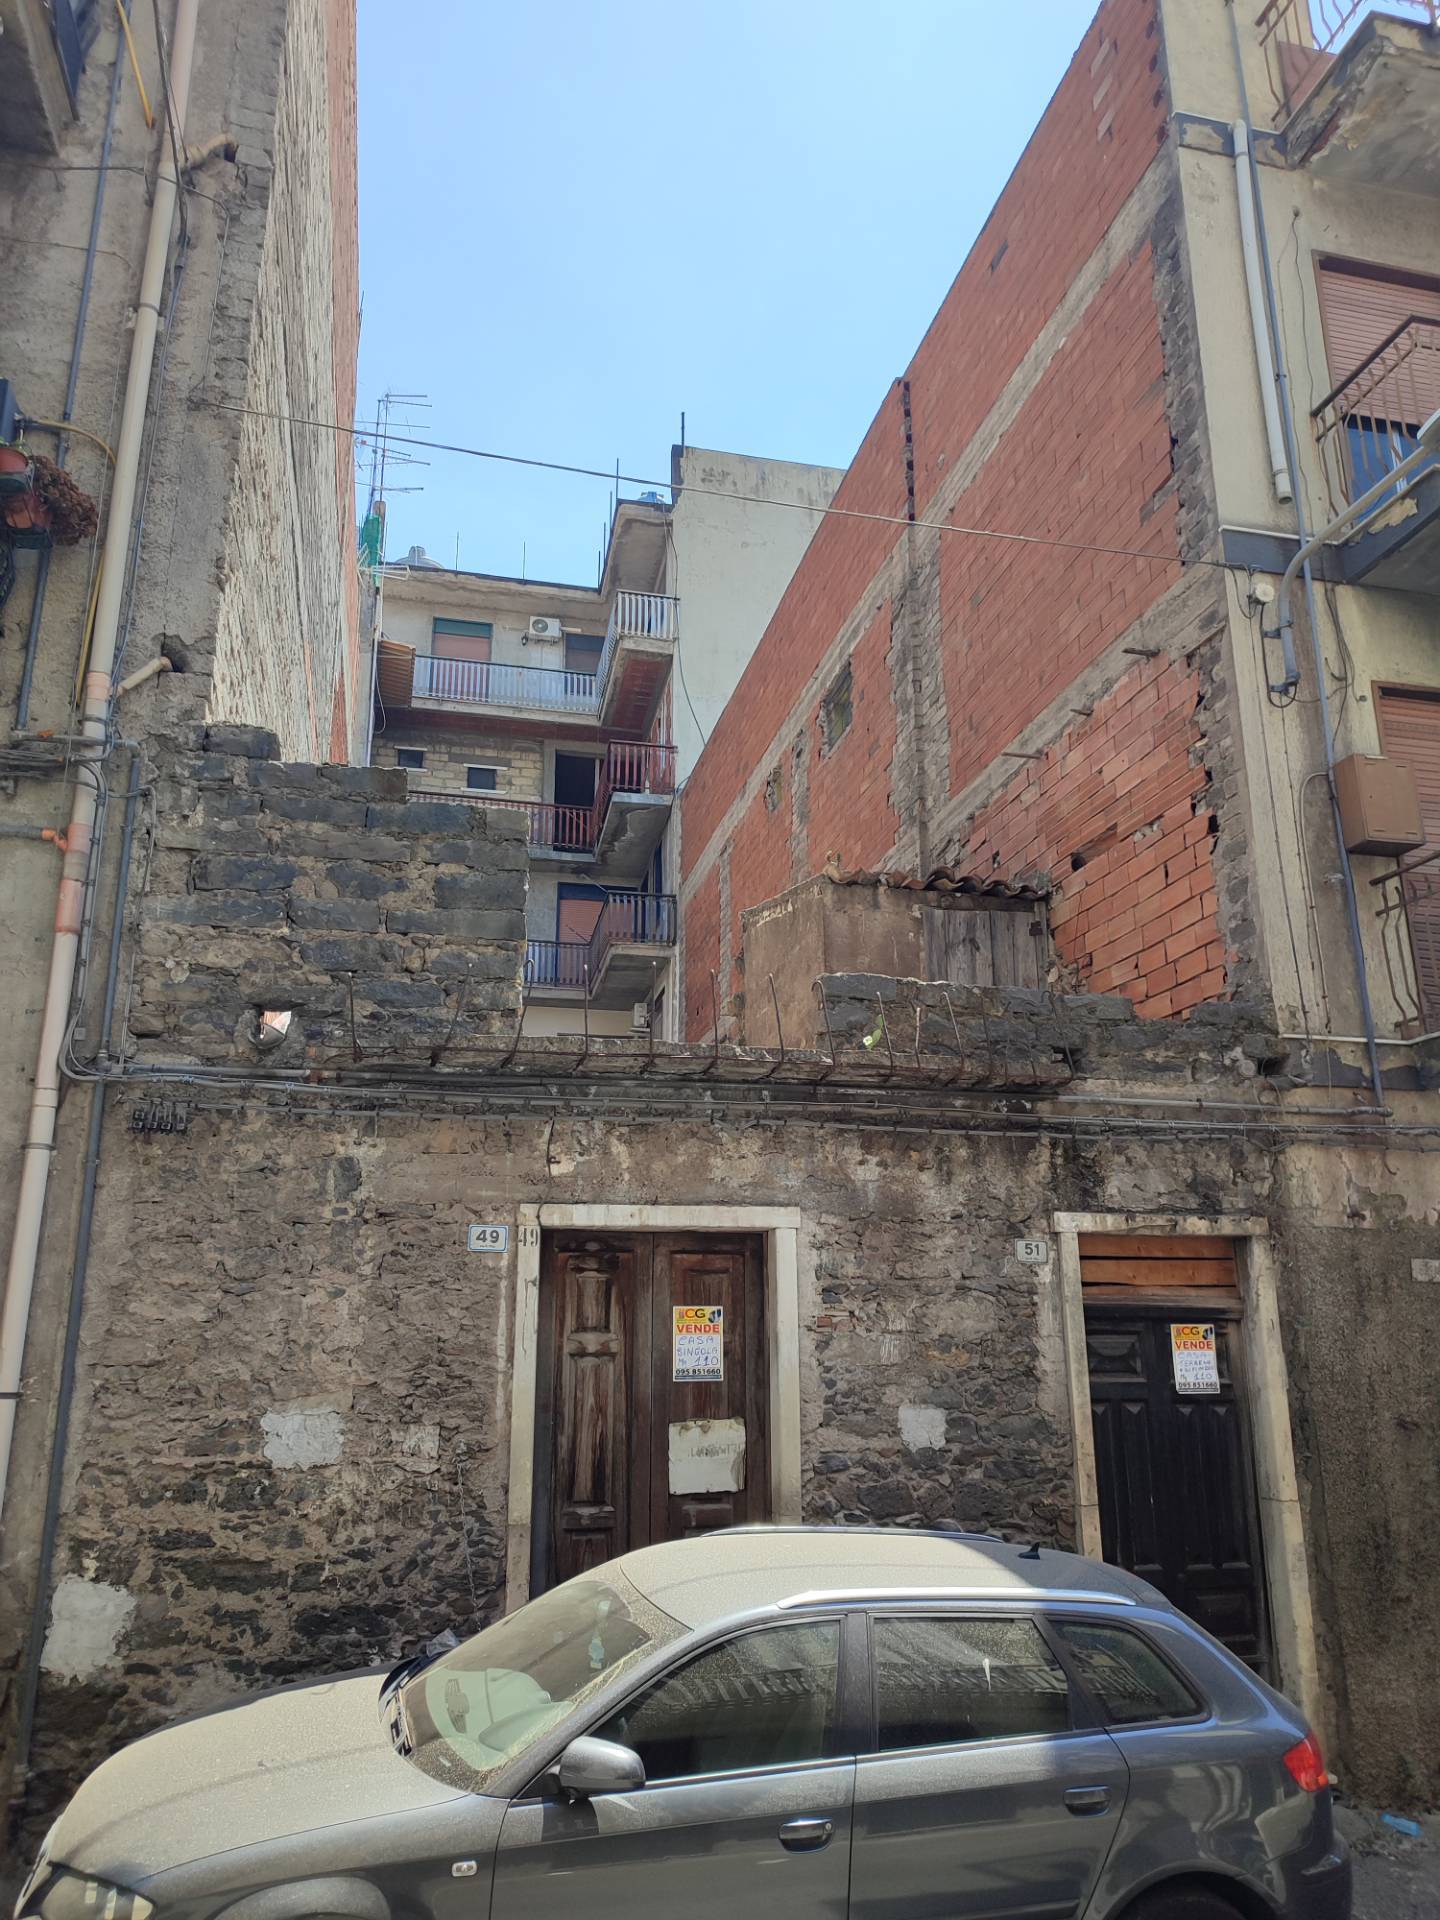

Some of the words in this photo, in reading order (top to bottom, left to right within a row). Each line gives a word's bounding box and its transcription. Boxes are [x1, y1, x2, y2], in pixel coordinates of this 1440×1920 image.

[476, 1229, 500, 1243] 49
[519, 1228, 539, 1247] 49
[1024, 1243, 1040, 1256] 51
[676, 1324, 720, 1333] VENDE
[679, 1335, 714, 1345] CASA
[1175, 1340, 1213, 1350] VENDE
[691, 1355, 719, 1367] 110
[1194, 1372, 1213, 1380] 110
